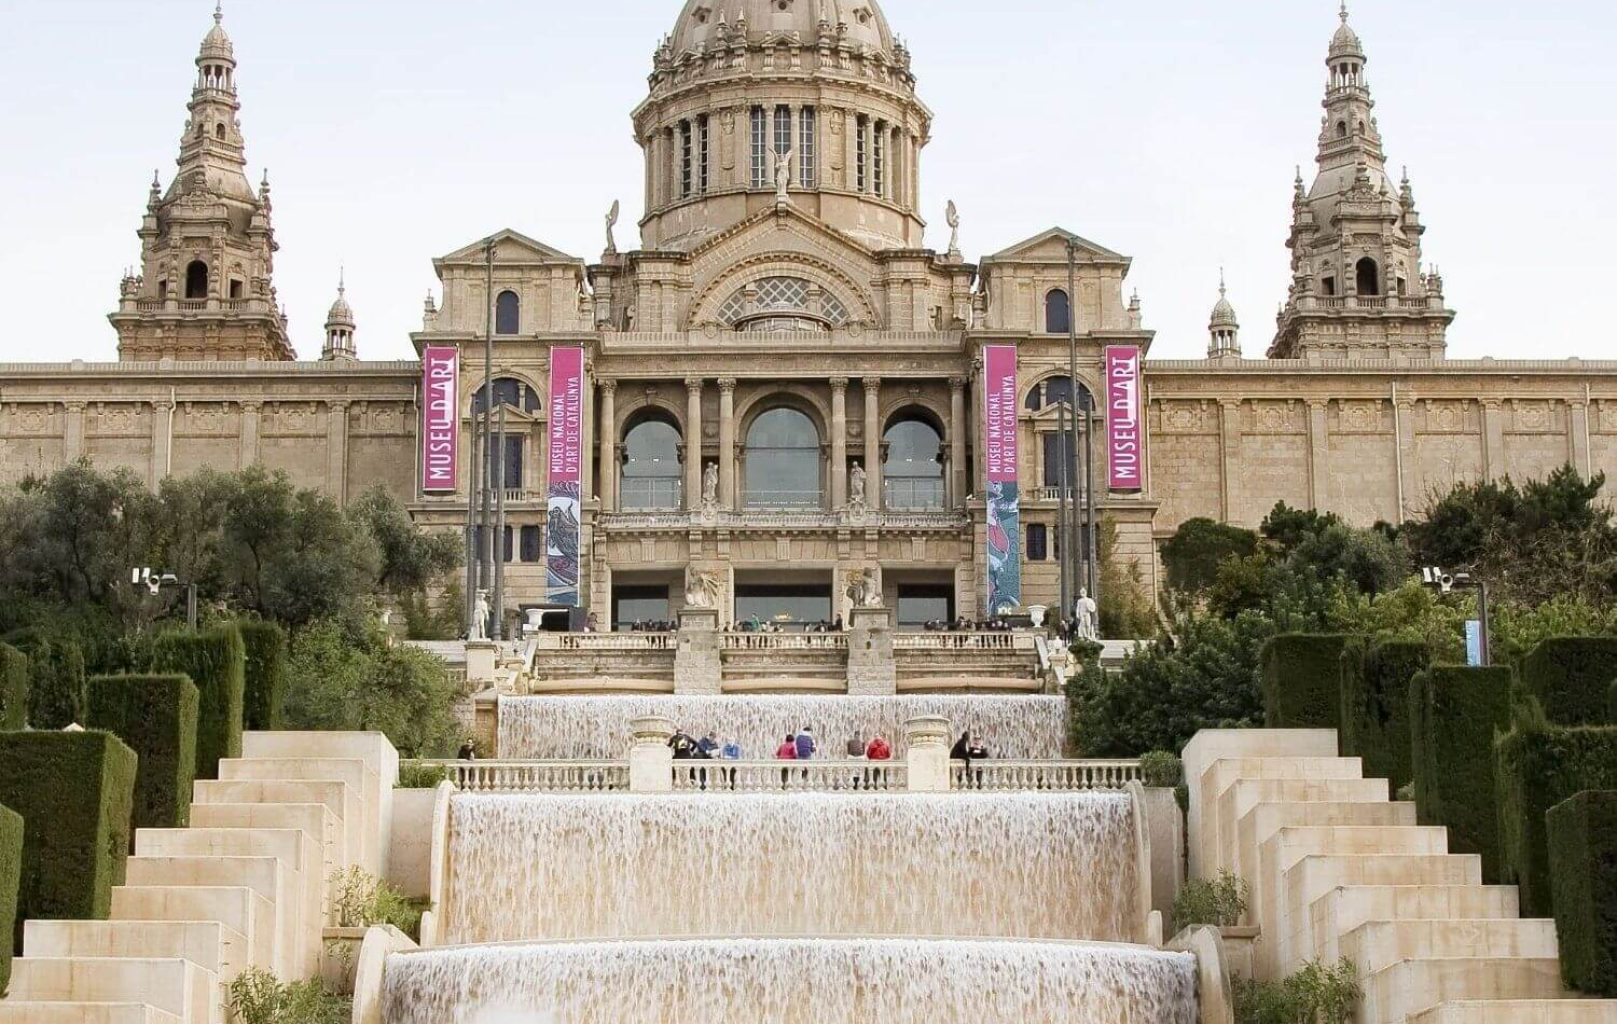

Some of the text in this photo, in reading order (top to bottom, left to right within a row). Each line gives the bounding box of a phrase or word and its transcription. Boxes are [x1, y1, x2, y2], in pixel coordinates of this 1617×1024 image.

[430, 358, 454, 480] MUSEU D'ART
[552, 393, 565, 472] MUSEU NACIONAL
[566, 376, 578, 472] D'ART DE CATALUNYA
[989, 392, 1001, 472] MUSEU NACIONAL
[1002, 376, 1016, 472] D'ART DE CATALUNYA
[1112, 357, 1136, 478] MUSEU D'ART
